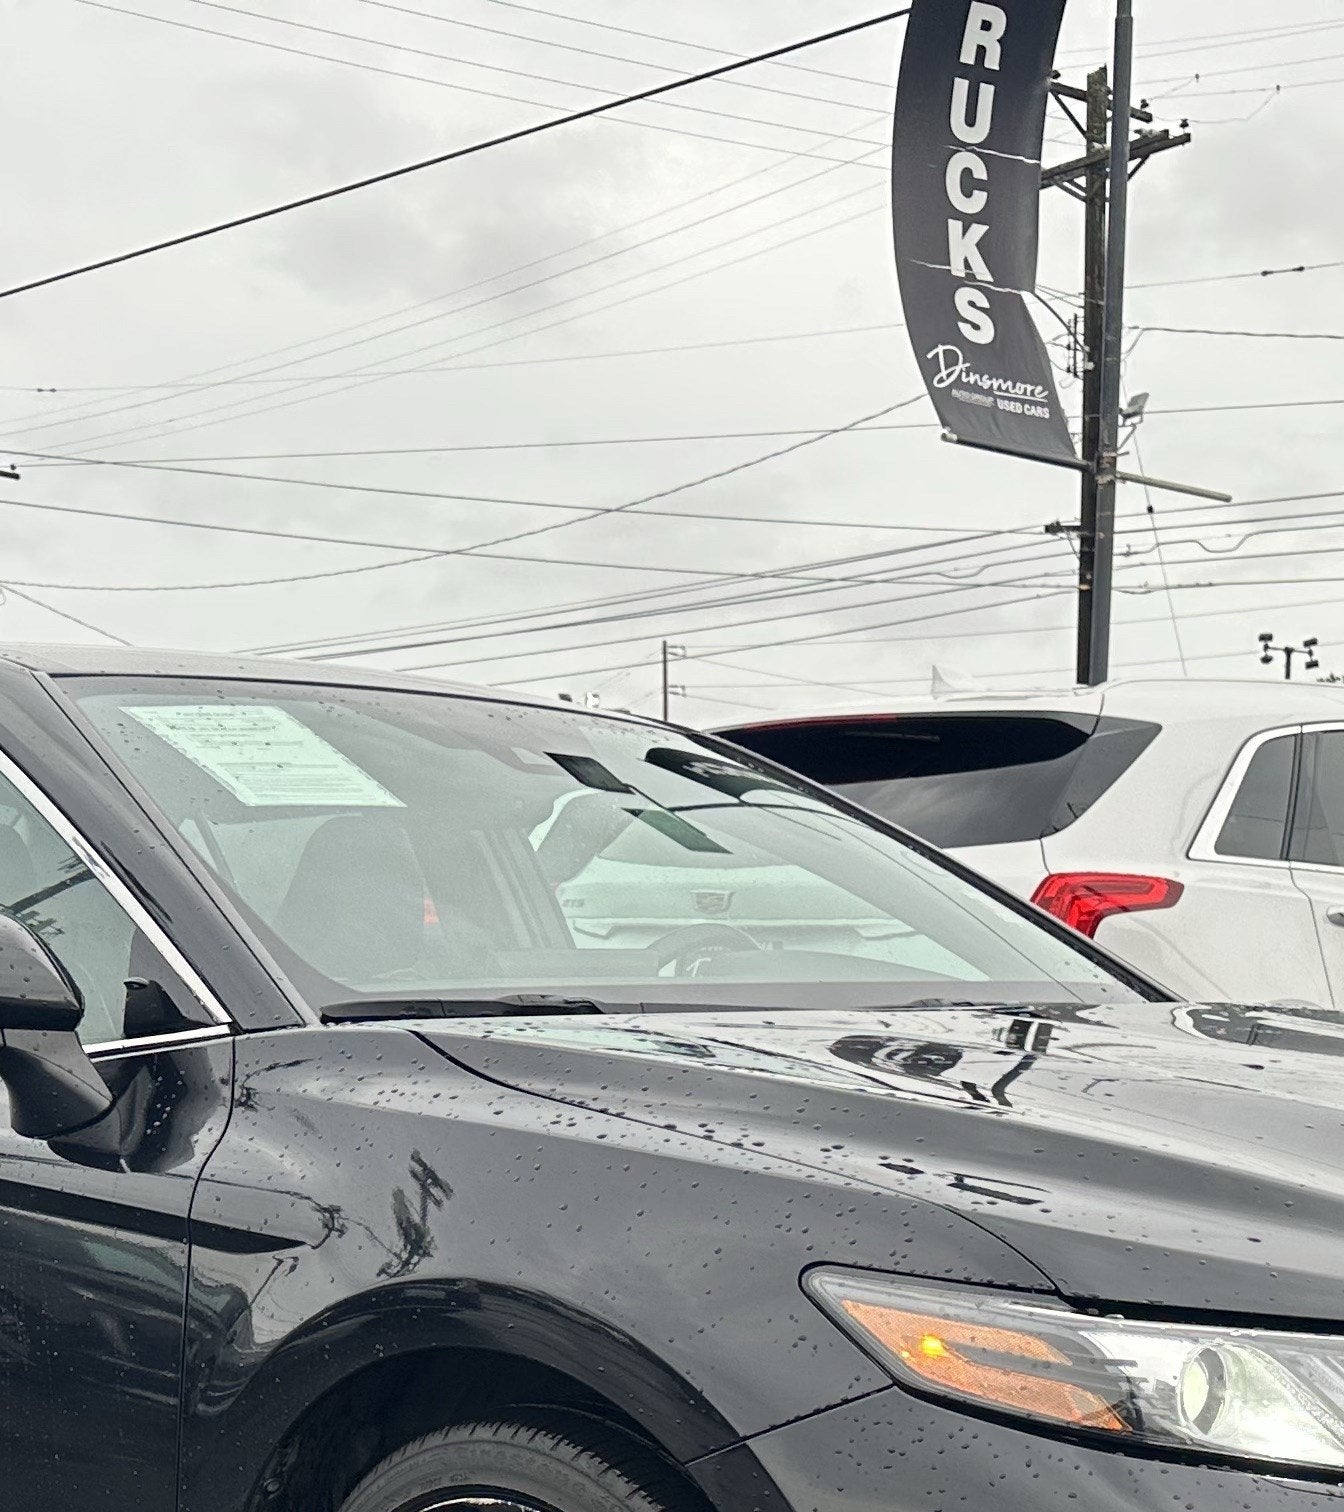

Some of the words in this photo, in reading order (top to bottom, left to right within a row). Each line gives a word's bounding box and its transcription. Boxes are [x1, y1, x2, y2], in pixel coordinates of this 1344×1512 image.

[926, 344, 1049, 398] Dinsmore
[996, 398, 1023, 414] USED
[1023, 403, 1050, 419] CARS
